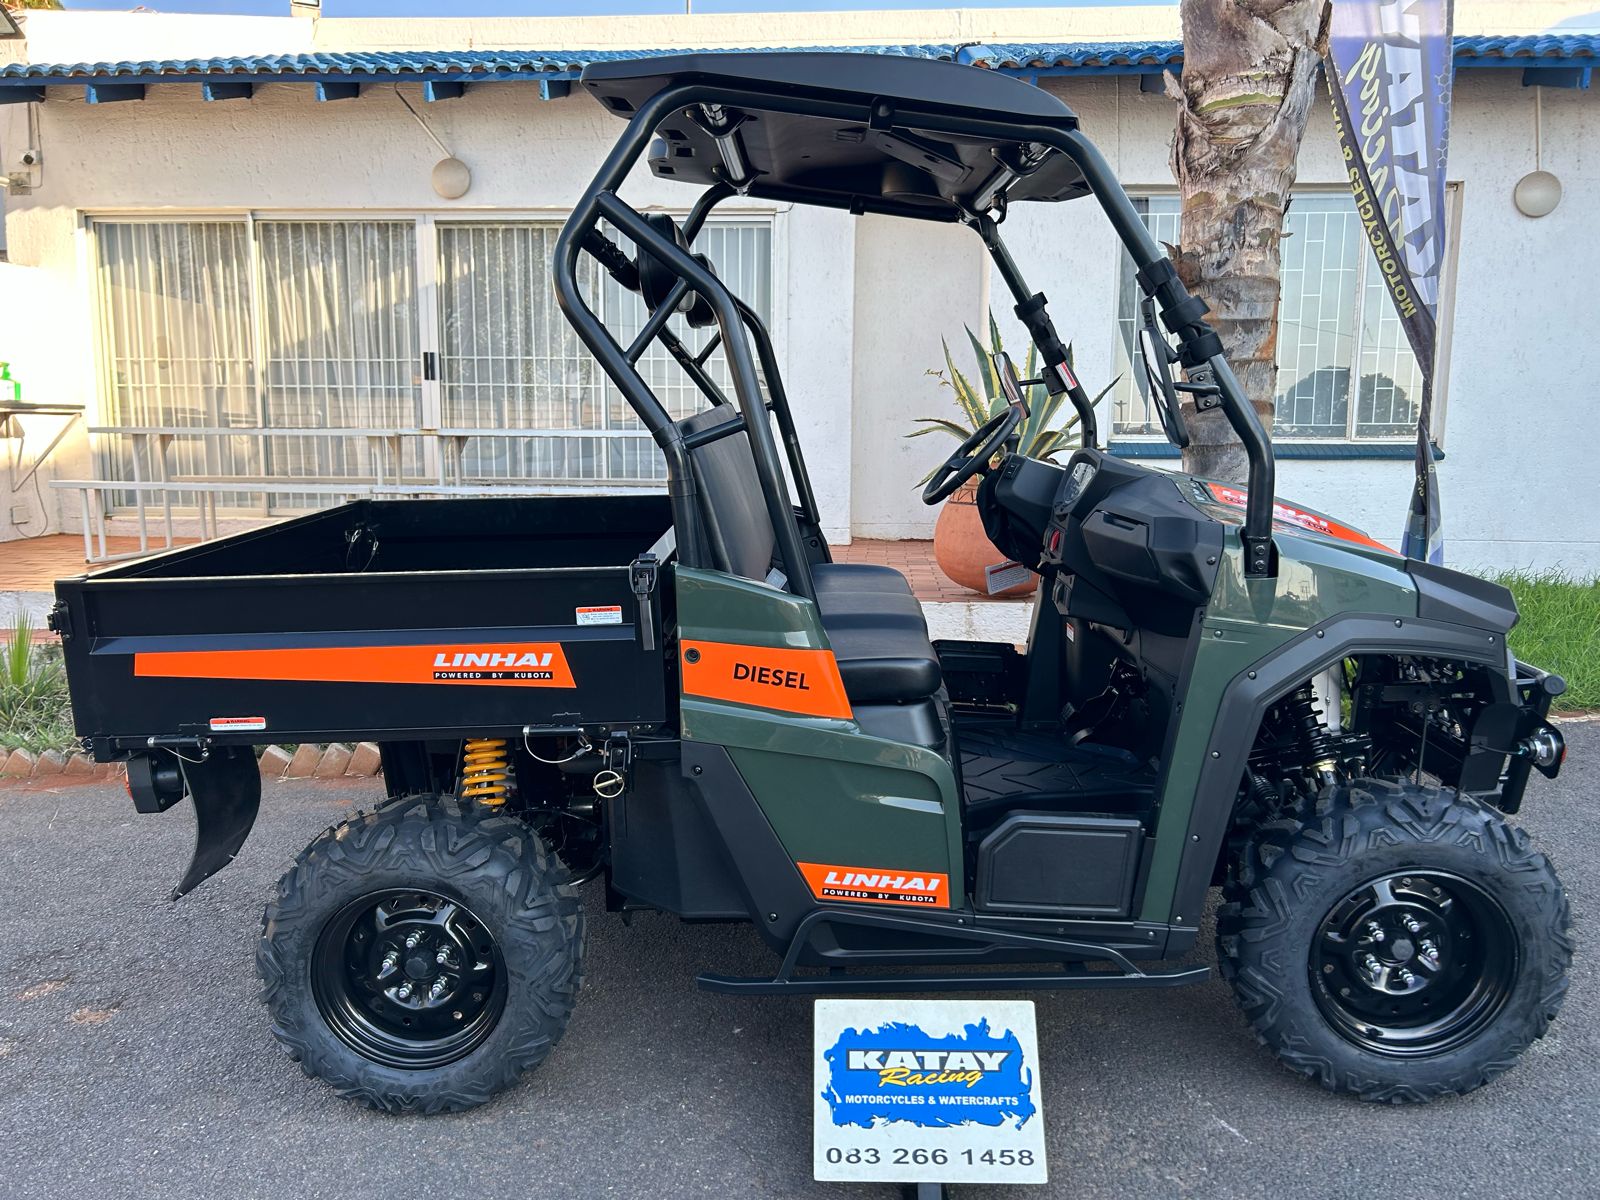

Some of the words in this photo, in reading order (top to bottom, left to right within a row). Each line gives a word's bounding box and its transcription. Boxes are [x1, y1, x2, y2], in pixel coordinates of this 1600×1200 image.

[1349, 167, 1417, 319] MOTORCYCLES
[433, 653, 553, 667] LINHAI
[733, 663, 810, 690] DIESEL
[824, 871, 940, 891] LINHAI
[824, 889, 868, 899] POWERED
[900, 895, 935, 903] KUBOTA
[848, 1050, 1009, 1072] KATAY
[878, 1066, 984, 1088] Racing
[845, 1095, 925, 1105] MOTORCYCLES
[928, 1096, 936, 1105] &
[939, 1096, 1019, 1106] WATERCRAFTS
[826, 1147, 881, 1165] 083
[892, 1148, 948, 1165] 266
[960, 1149, 1035, 1166] 1458
